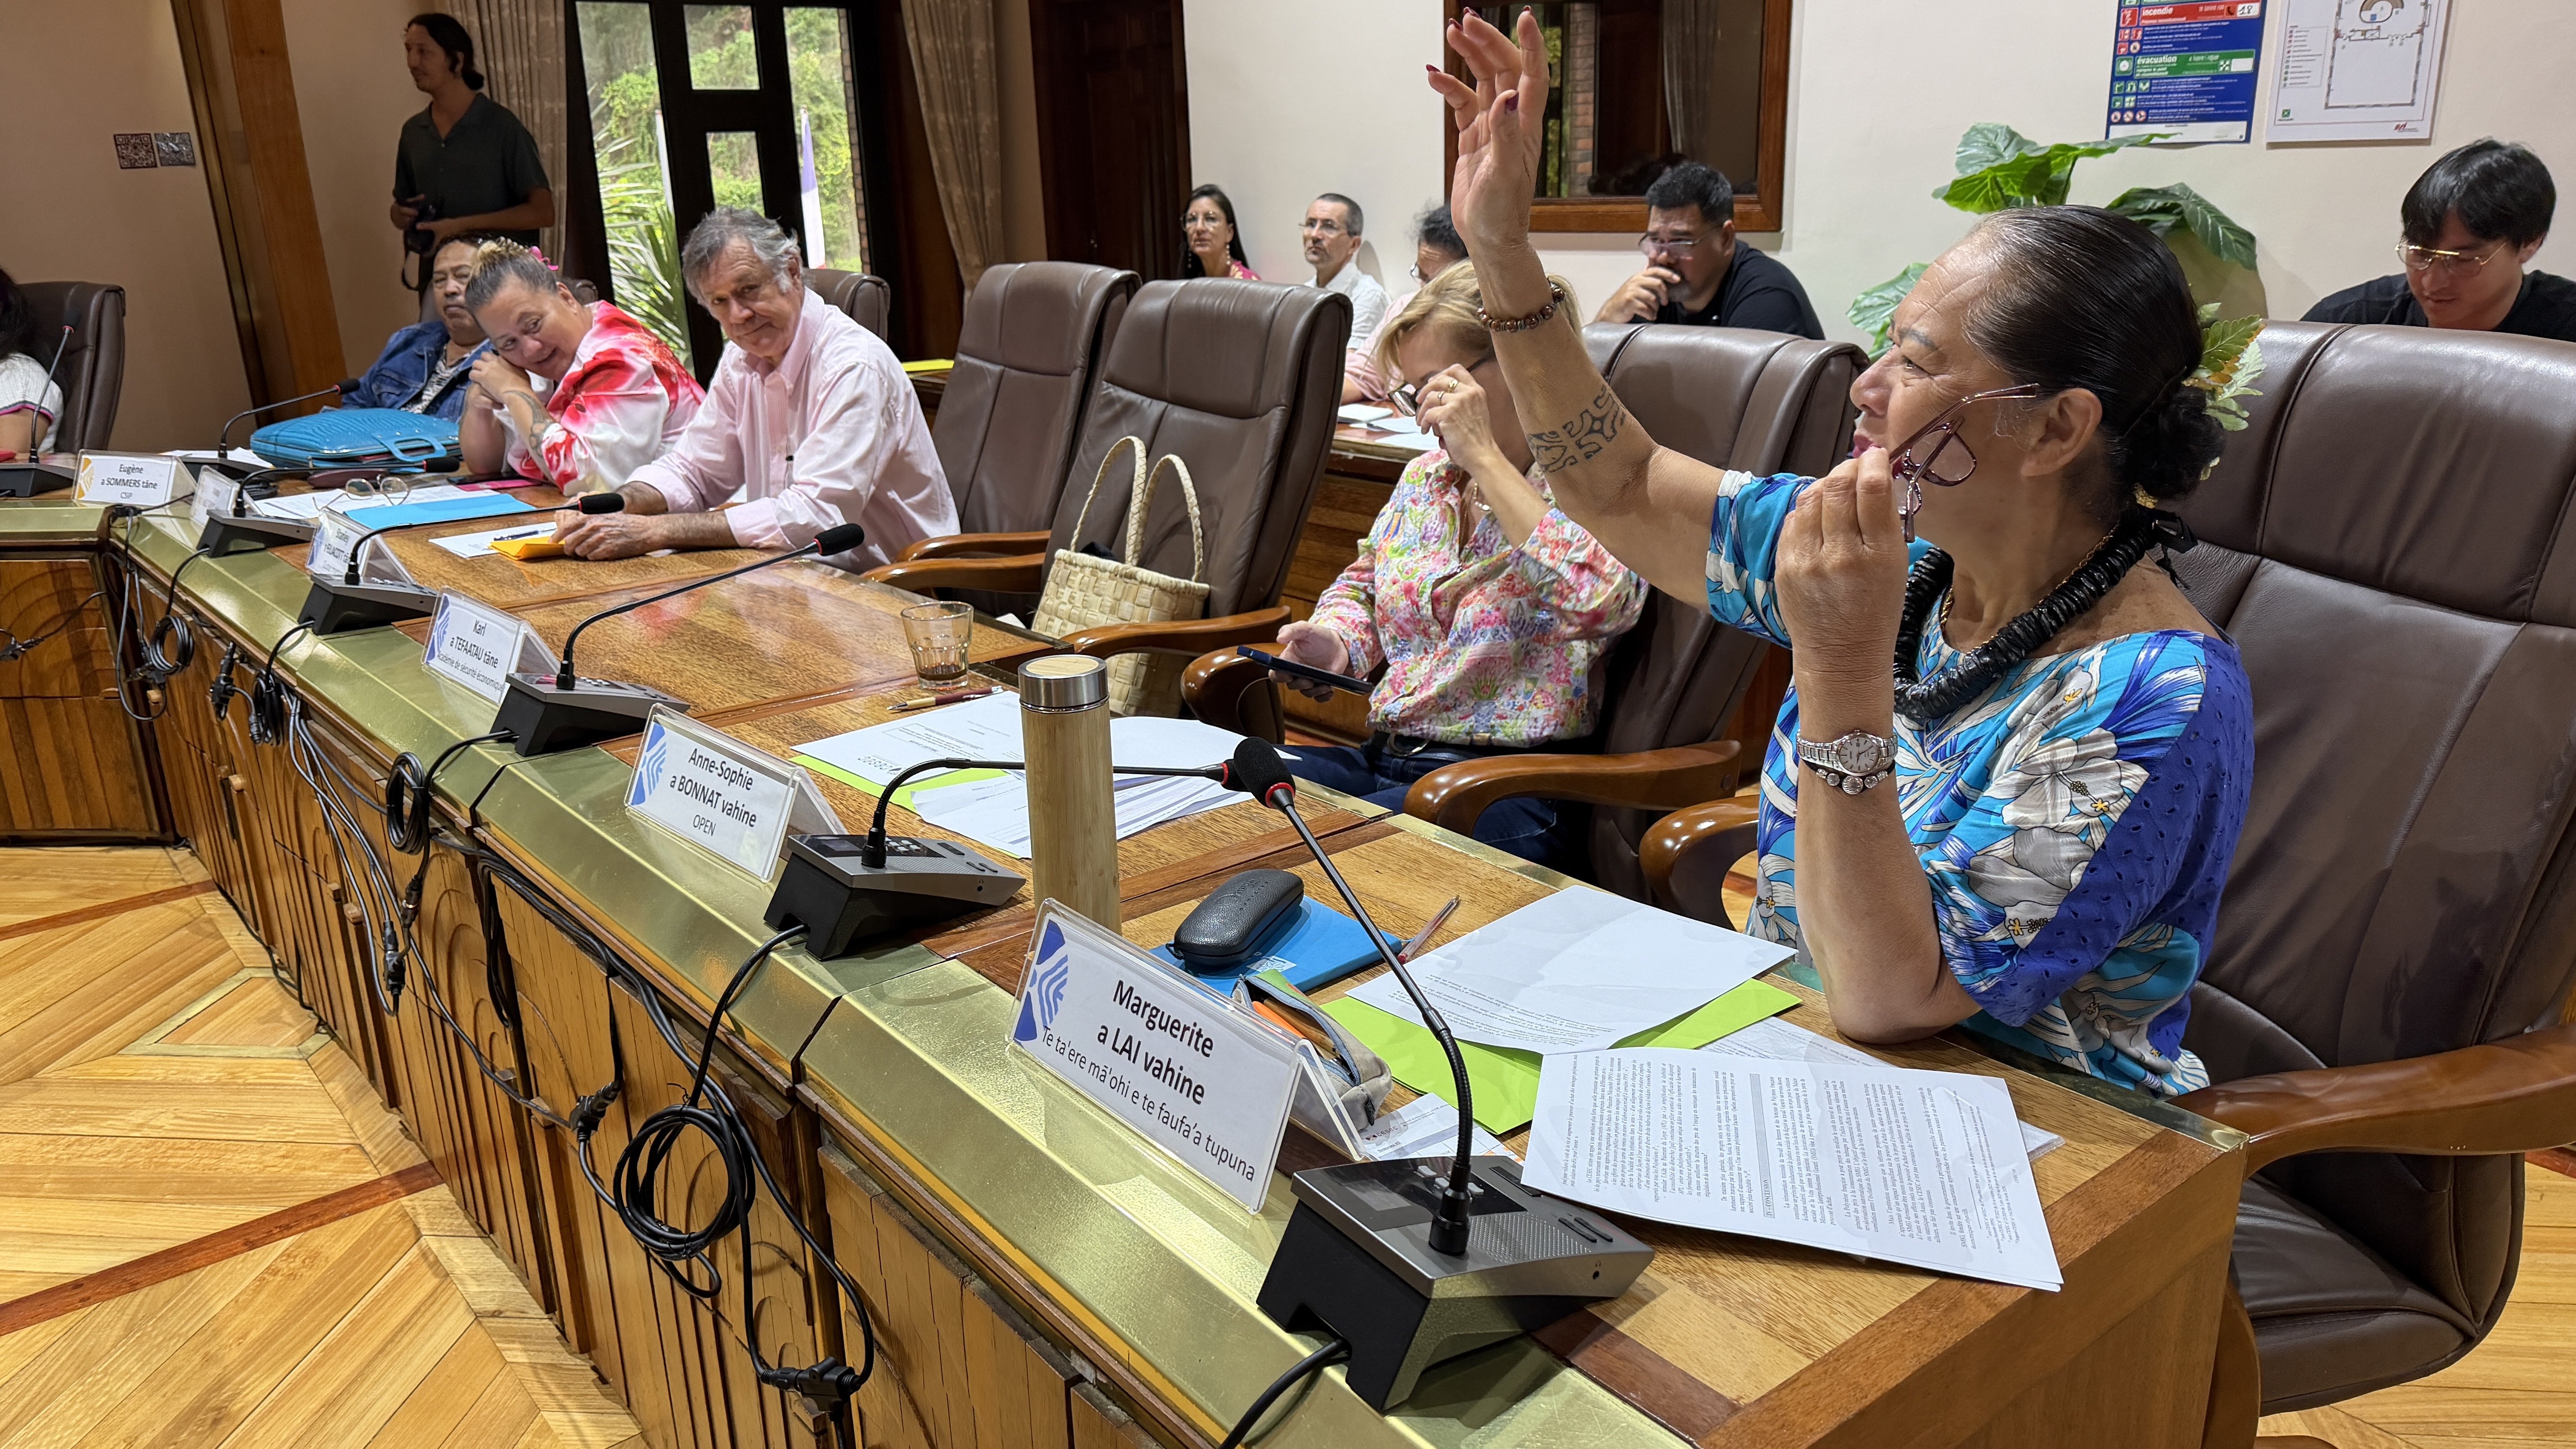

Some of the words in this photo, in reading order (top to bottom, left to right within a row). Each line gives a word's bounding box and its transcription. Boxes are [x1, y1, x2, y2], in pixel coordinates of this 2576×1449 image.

[2239, 5, 2251, 15] 18
[2137, 55, 2177, 64] évacuation
[119, 464, 144, 474] Eugène
[106, 478, 141, 488] SOMMERS
[473, 620, 487, 636] Karl
[450, 637, 454, 647] a
[455, 636, 484, 661] TEFAATAU
[483, 651, 498, 668] tāne
[688, 748, 753, 791] Anne-Sophie
[670, 775, 676, 788] a
[678, 775, 722, 809] BONNAT
[722, 799, 757, 828] vahine
[693, 814, 716, 836] OPEN
[1113, 980, 1214, 1058] Marguerite
[1097, 1023, 1109, 1043] a
[1112, 1027, 1141, 1064] LAI
[1144, 1048, 1205, 1105] vahine
[1042, 1026, 1053, 1047] Te
[1054, 1035, 1086, 1069] ta'ere
[1088, 1058, 1131, 1098] mā'ohi
[1132, 1087, 1140, 1104] e
[1143, 1093, 1155, 1115] te
[1157, 1103, 1202, 1145] faufa'a
[1205, 1135, 1256, 1182] tupuna
[1763, 1179, 1772, 1206] CONCLUSION
